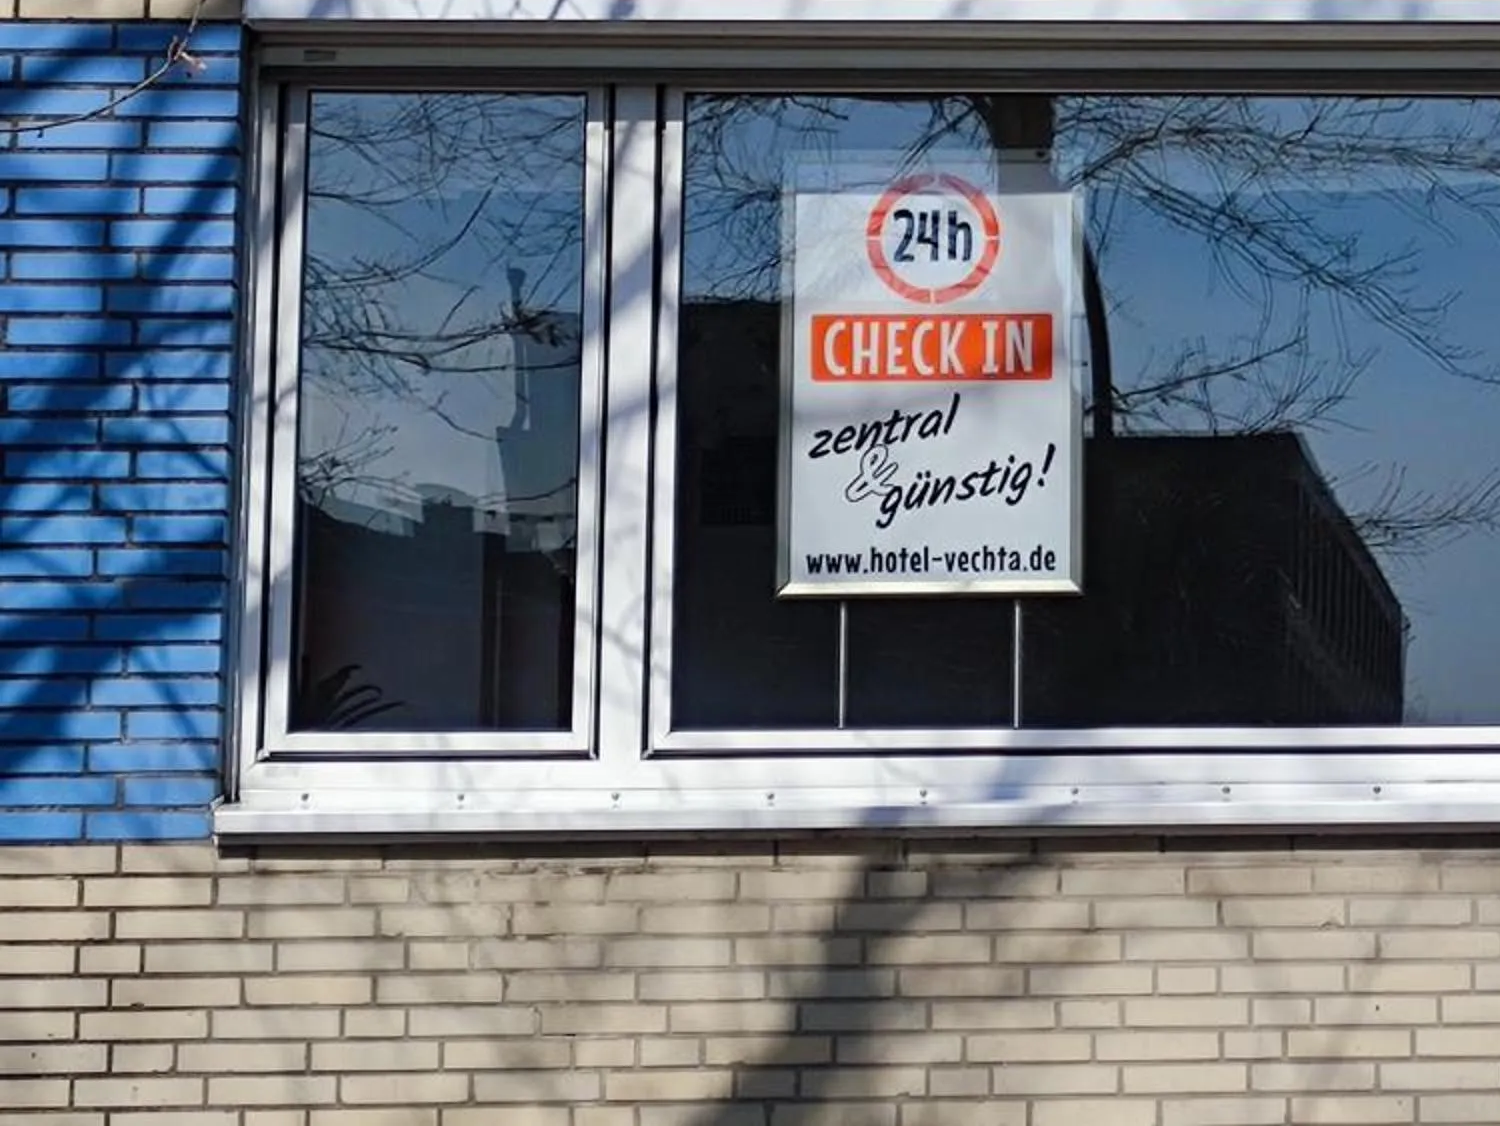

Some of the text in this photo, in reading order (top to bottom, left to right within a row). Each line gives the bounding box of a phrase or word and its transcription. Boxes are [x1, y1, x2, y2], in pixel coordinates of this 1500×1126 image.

[893, 209, 973, 262] 24h
[824, 320, 1034, 376] CHECK IN
[808, 393, 960, 459] zentral
[876, 443, 1056, 529] günstig!
[806, 545, 1057, 575] www.hotel-vechta.de
